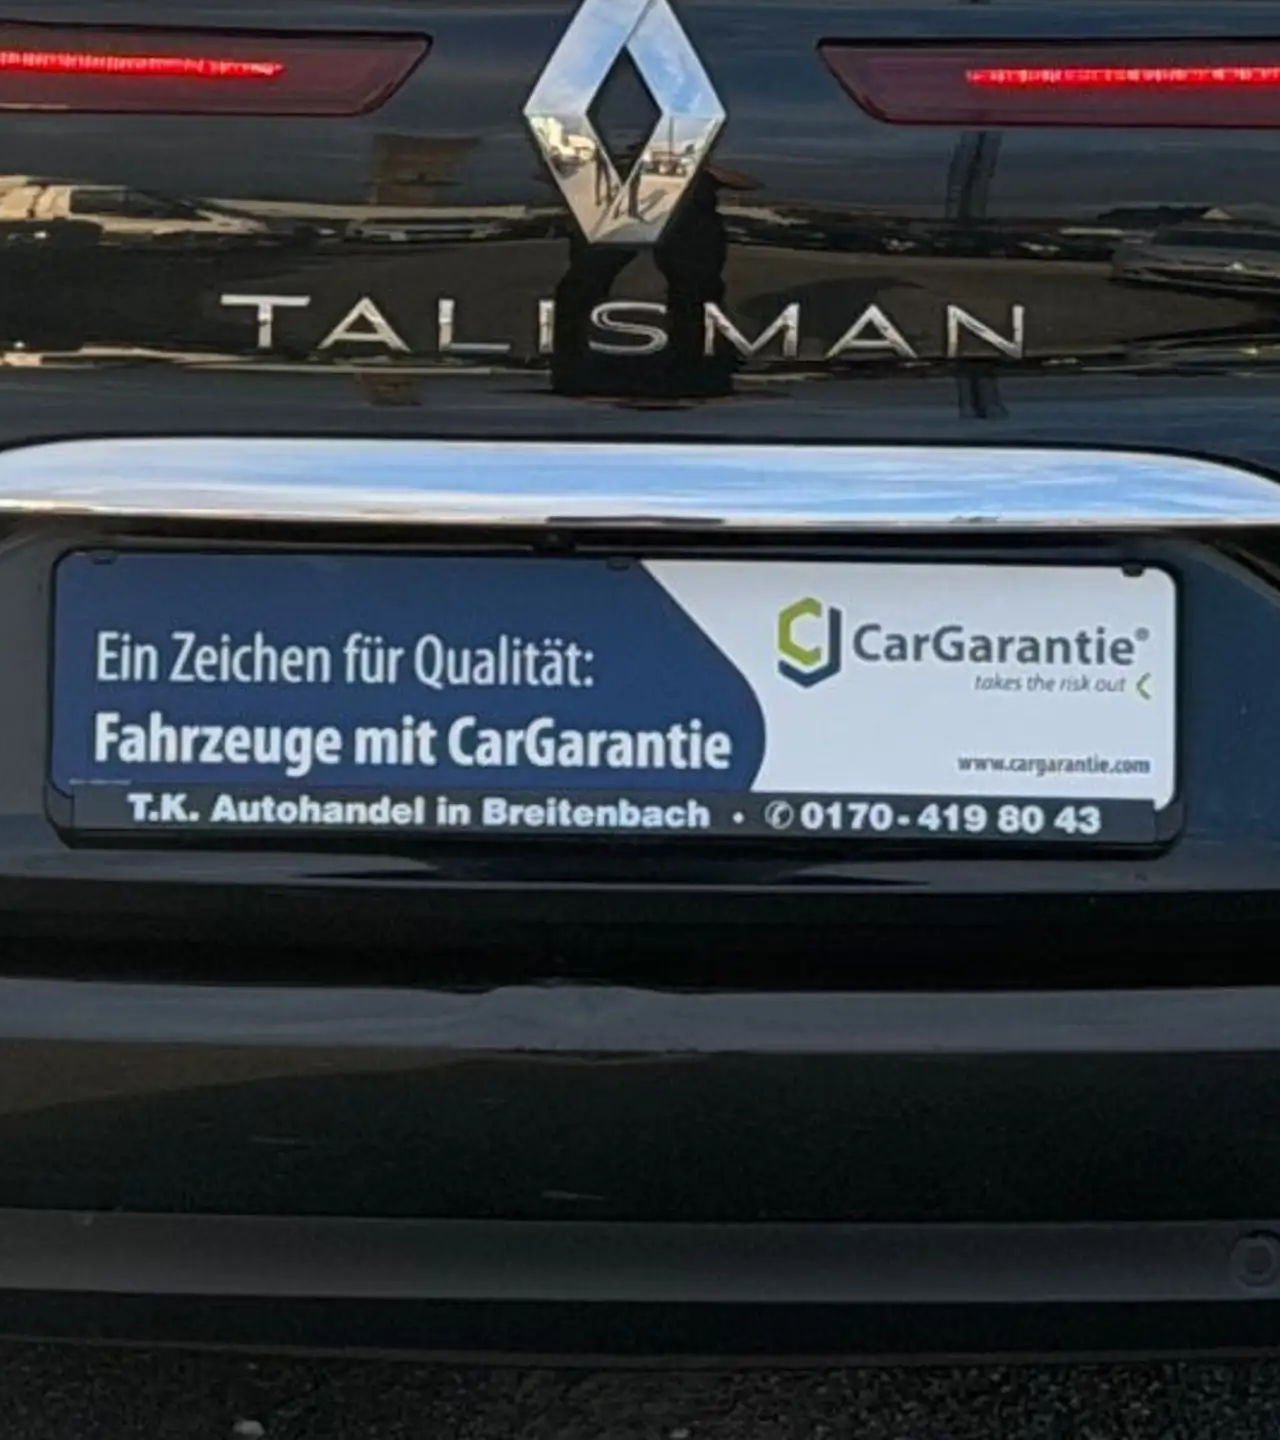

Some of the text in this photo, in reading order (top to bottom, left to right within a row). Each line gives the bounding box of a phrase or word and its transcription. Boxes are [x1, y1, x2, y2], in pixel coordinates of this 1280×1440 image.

[220, 293, 1026, 359] TALISMAN
[96, 630, 595, 690] Ein Zeichen für Qualität:
[974, 672, 1127, 693] takes the risk out
[95, 711, 733, 778] Fahrzeuge mit CarGarantie
[957, 753, 1151, 778] www.cargarantie.com
[126, 792, 200, 822] T.K.
[210, 793, 425, 825] Autohandel
[436, 795, 471, 826] in
[482, 796, 711, 829] Breitenbach
[997, 804, 1044, 834] 80
[1054, 805, 1102, 835] 43
